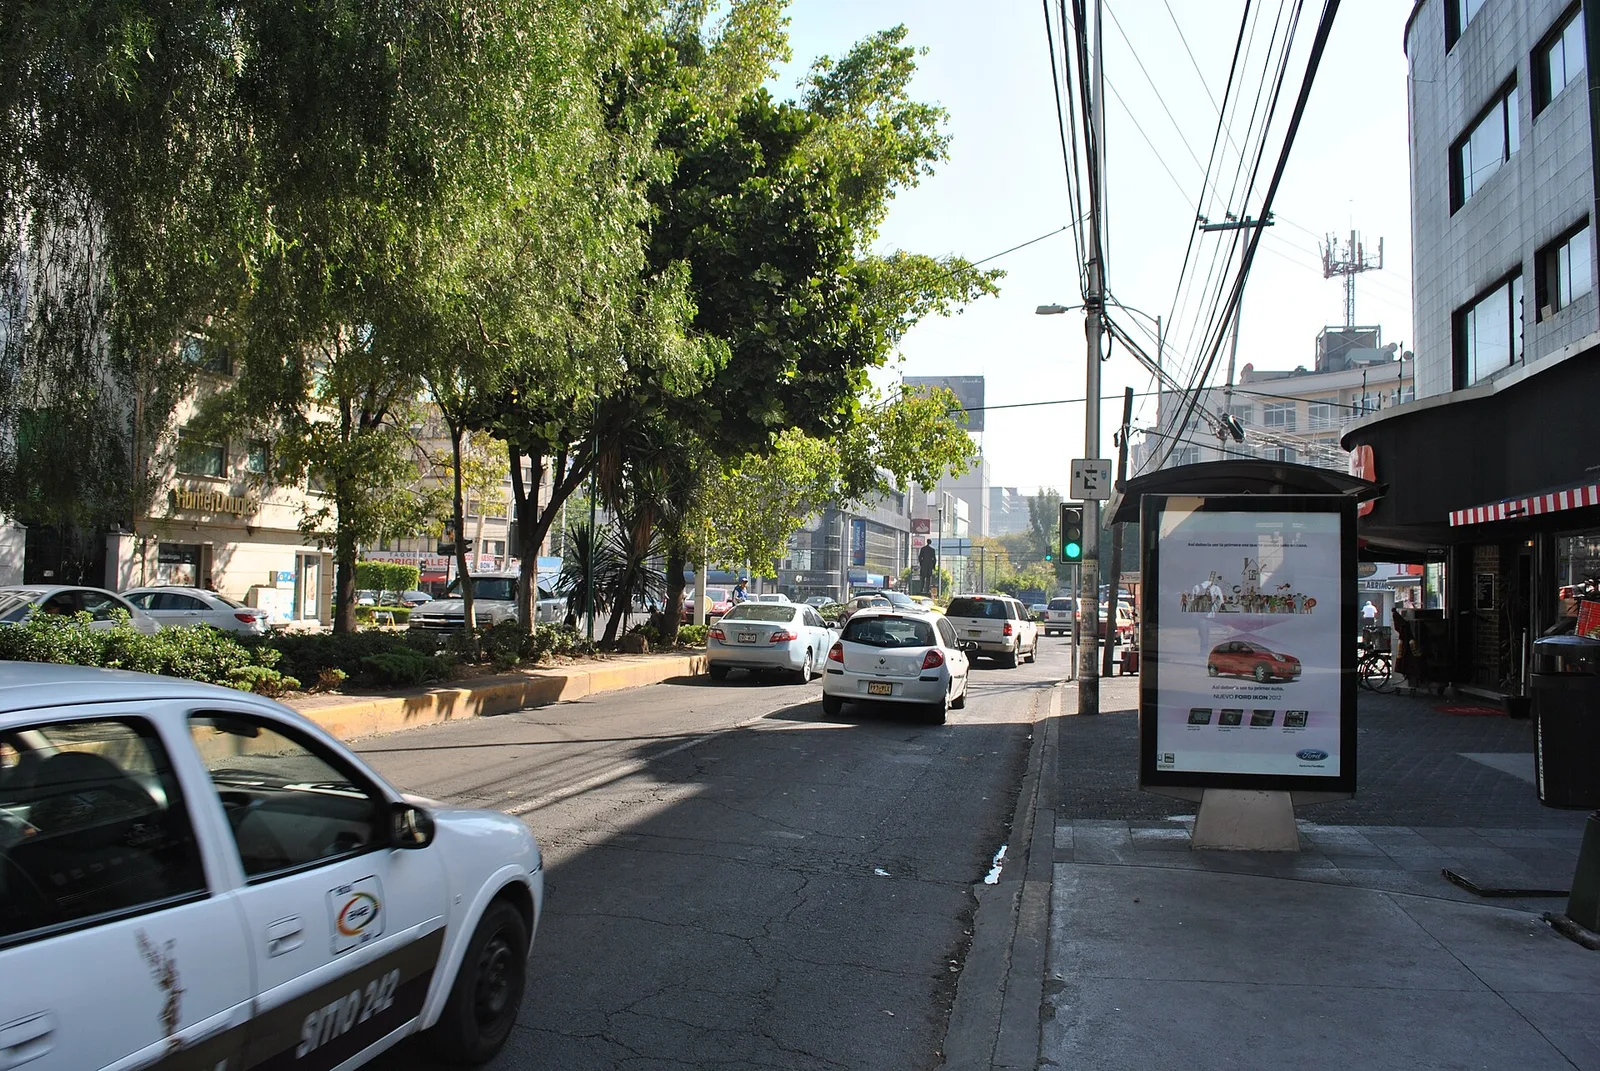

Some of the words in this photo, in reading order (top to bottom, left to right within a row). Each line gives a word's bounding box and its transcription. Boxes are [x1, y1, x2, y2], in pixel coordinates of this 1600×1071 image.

[387, 558, 449, 566] ORIGIALES
[1302, 751, 1322, 759] Ford
[296, 988, 362, 1059] SITIO
[357, 968, 400, 1024] 242
